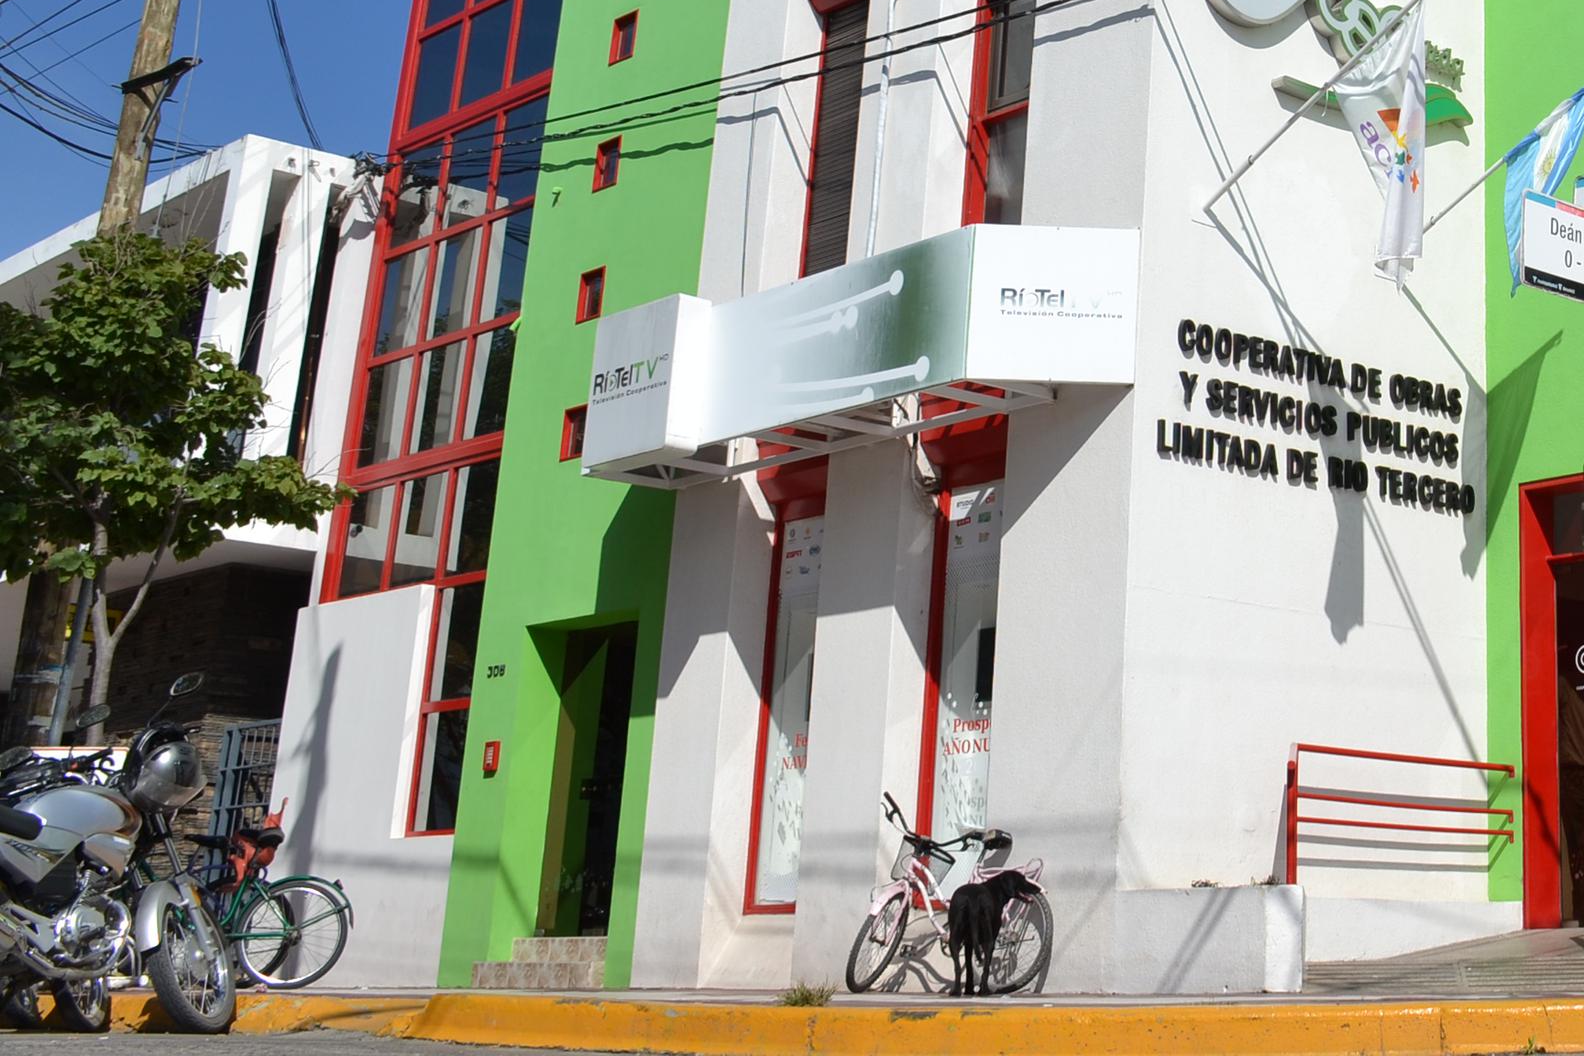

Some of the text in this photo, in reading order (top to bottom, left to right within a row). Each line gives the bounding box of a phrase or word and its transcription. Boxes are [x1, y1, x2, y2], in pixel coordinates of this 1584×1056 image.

[1550, 217, 1582, 244] Deán
[1564, 250, 1573, 269] 0
[1178, 319, 1462, 420] COOPERATIVA DE OBRAS
[1179, 371, 1459, 465] Y SERVICIOS PUBLICOS
[1157, 419, 1475, 515] LIMITADA DE RIO TERCERO
[953, 718, 991, 734] Prosp
[944, 737, 971, 756] AÑO
